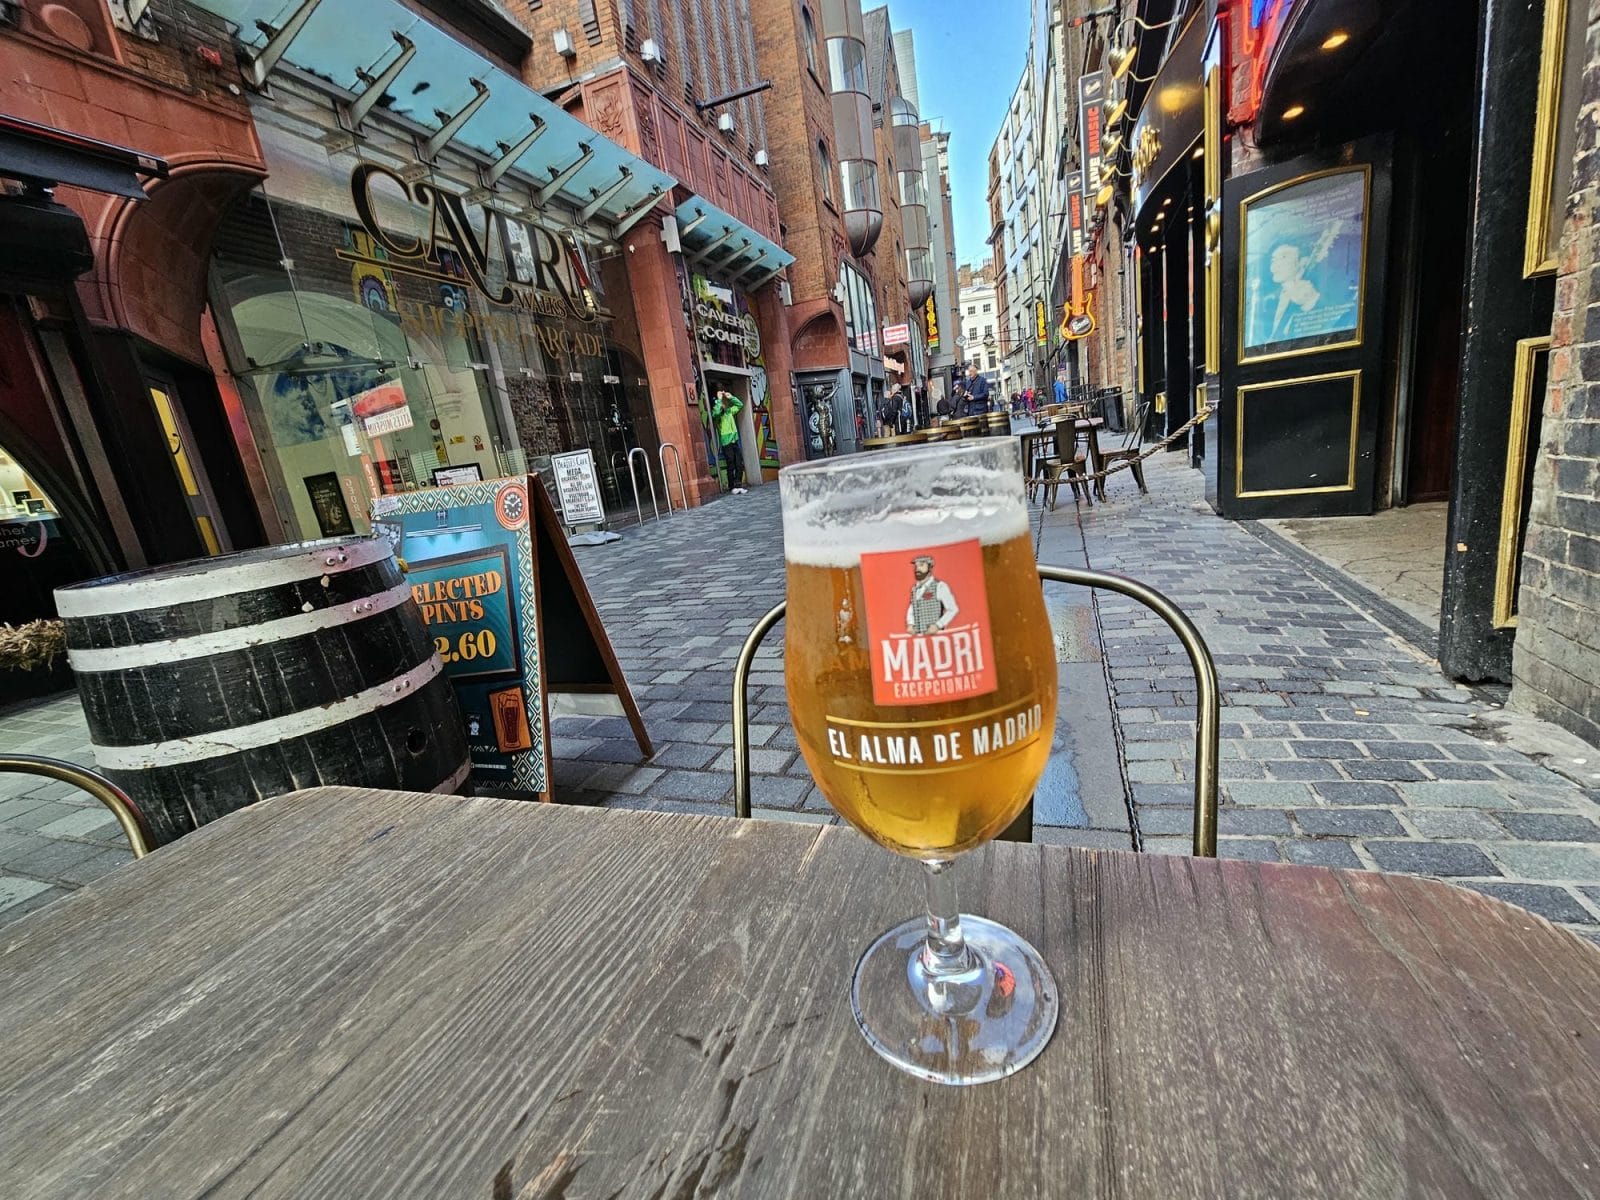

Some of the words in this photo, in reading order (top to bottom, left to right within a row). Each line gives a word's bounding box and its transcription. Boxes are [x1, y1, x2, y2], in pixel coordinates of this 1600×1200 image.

[1087, 106, 1100, 156] MUSIC
[1070, 193, 1080, 228] MUSIC
[350, 161, 600, 322] CAVERN
[515, 288, 567, 318] WALKS
[696, 303, 750, 331] CAVERN
[534, 323, 606, 360] ARCADE
[702, 325, 752, 348] COURT
[411, 570, 502, 605] ELECTED
[423, 600, 484, 625] PINTS
[827, 728, 852, 759] EL
[859, 734, 924, 765] ALMA
[934, 730, 962, 763] DE
[972, 703, 1042, 757] MADRID
